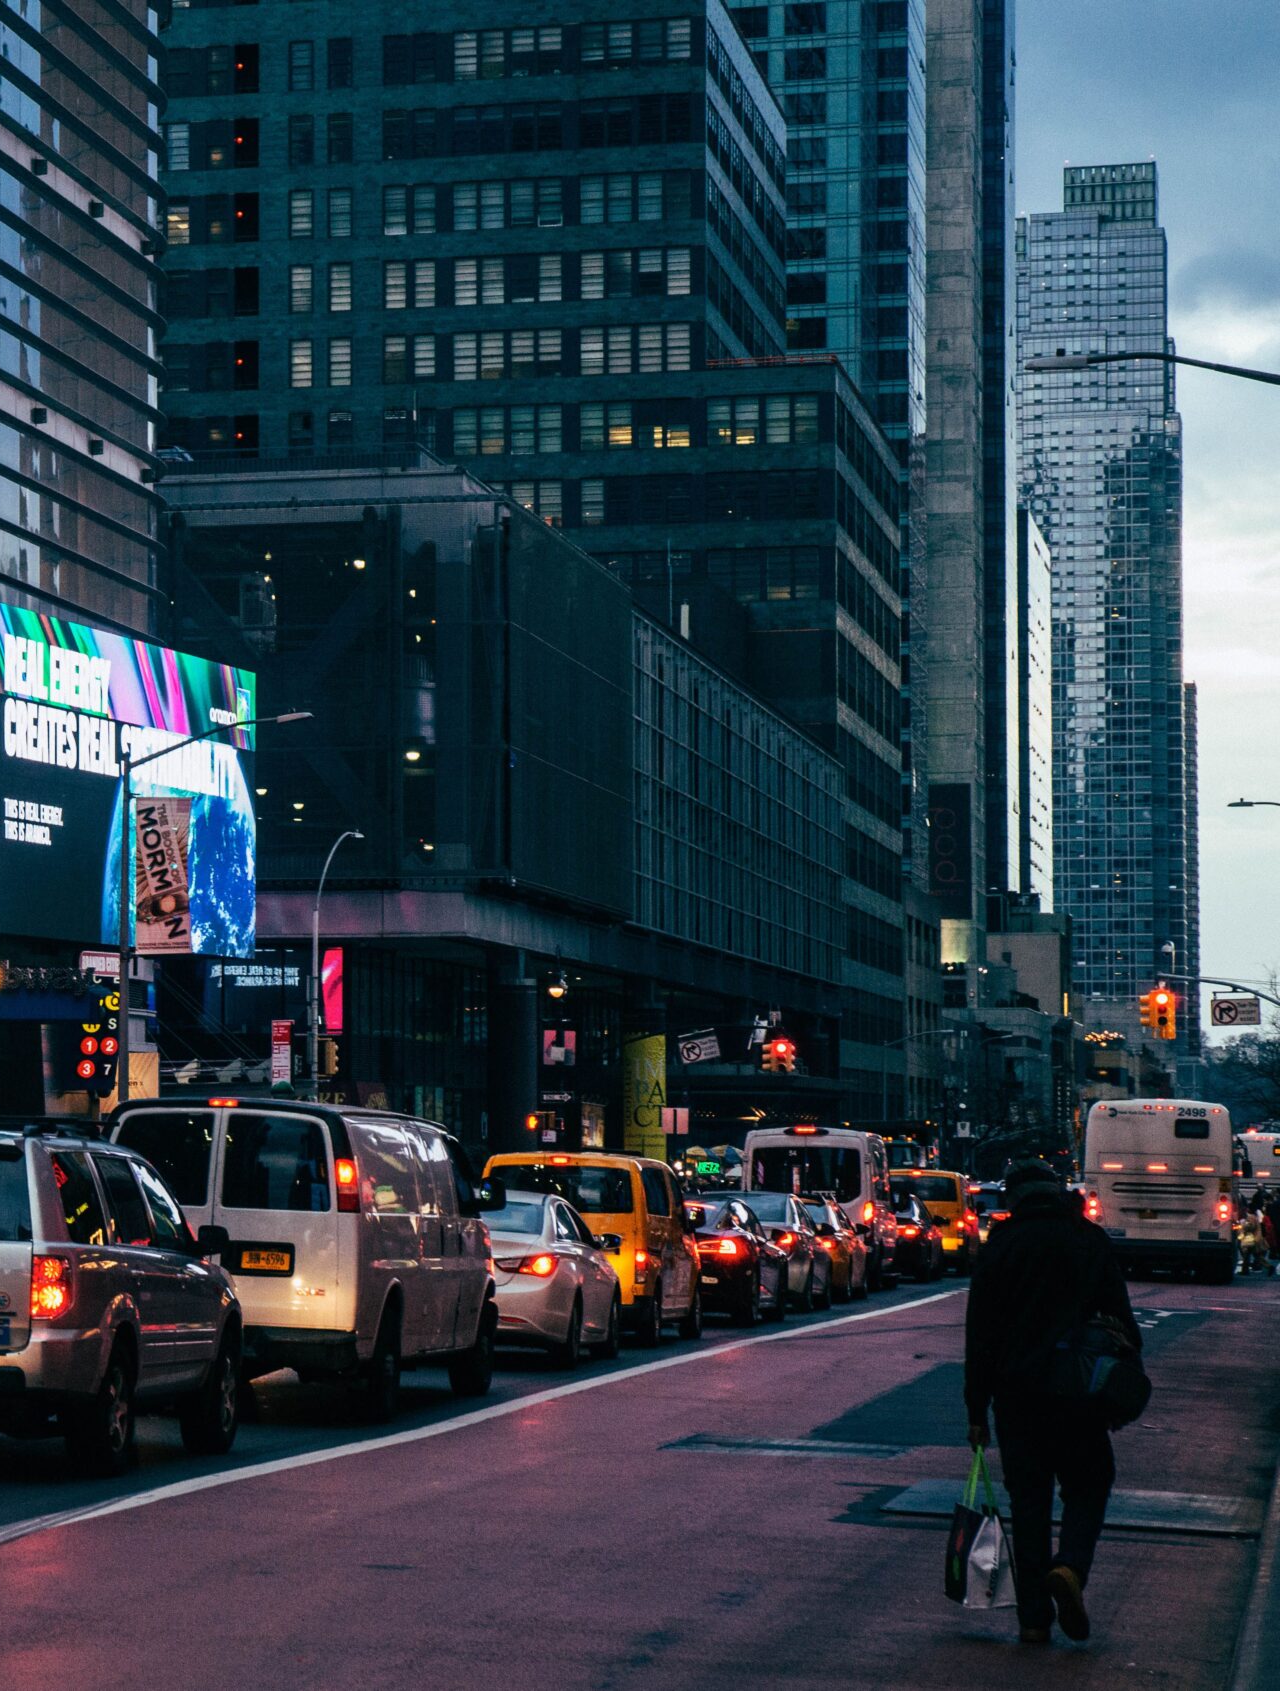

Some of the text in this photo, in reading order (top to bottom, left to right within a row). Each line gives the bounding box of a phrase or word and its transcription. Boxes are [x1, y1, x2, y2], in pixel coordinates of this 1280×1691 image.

[3, 633, 111, 718] REAL ENERGY
[3, 697, 77, 770] CREATES
[79, 714, 120, 778] REAL
[1177, 1107, 1207, 1118] 2498
